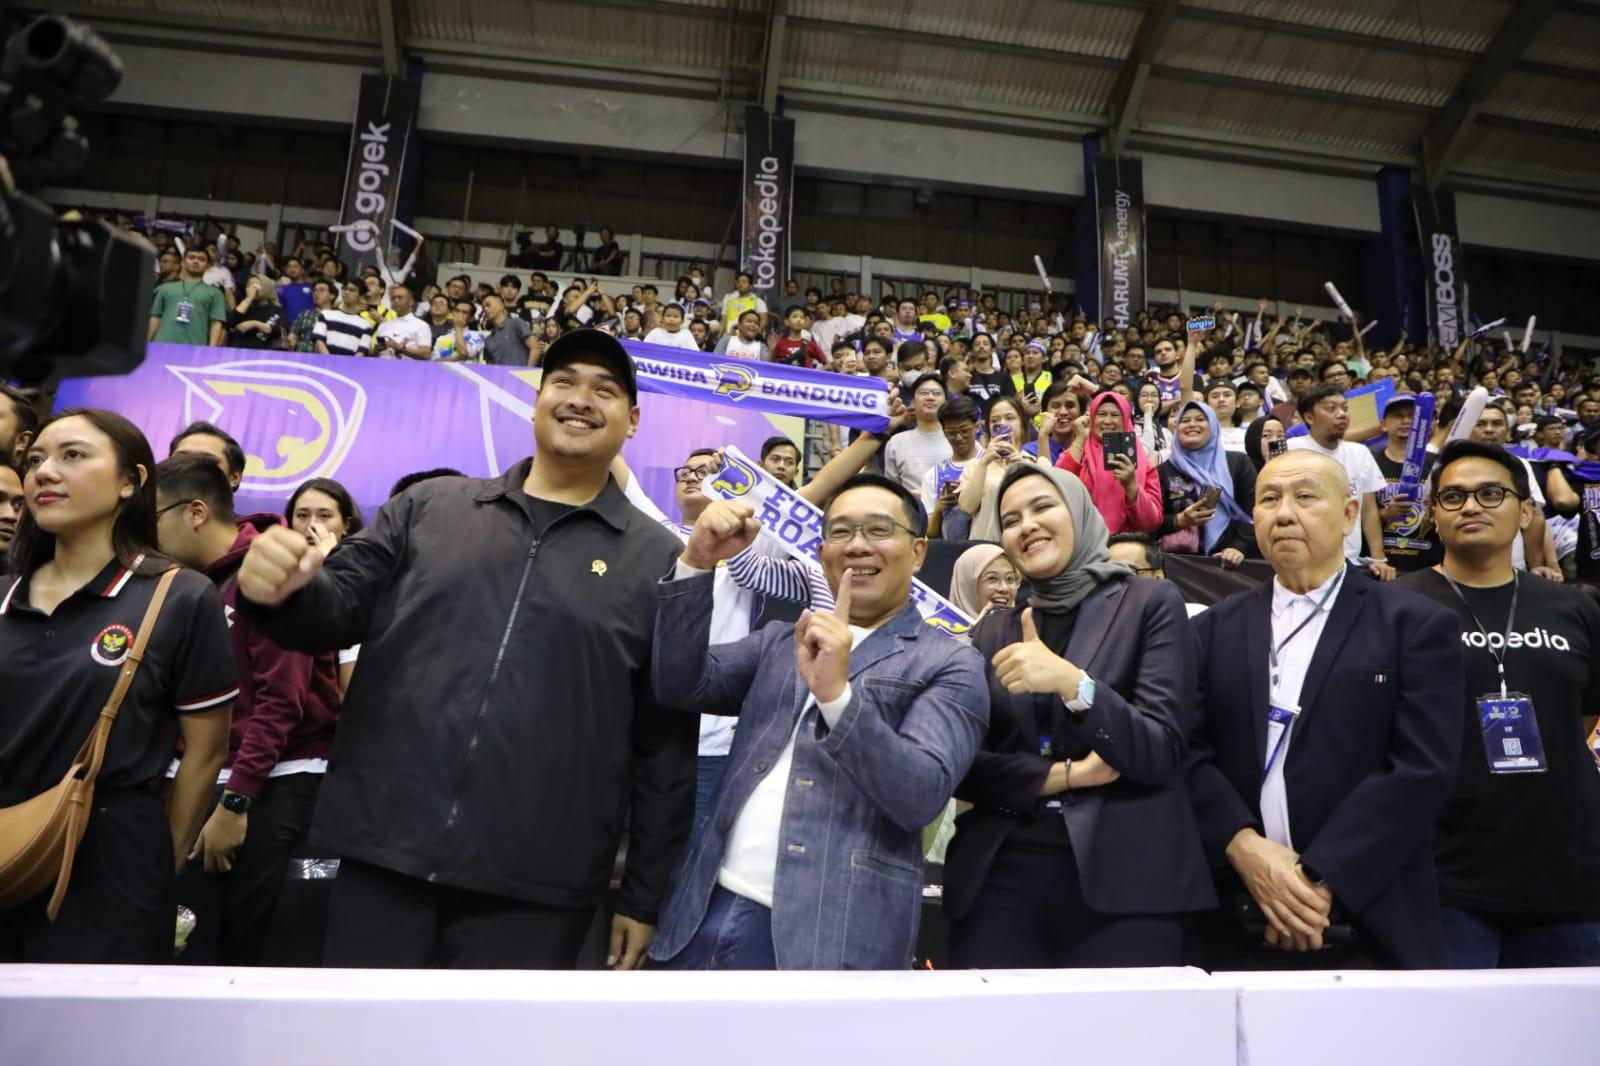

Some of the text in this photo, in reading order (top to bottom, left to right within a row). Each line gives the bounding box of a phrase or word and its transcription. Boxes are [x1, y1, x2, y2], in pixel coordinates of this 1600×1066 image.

[355, 121, 391, 215] gojek
[753, 156, 783, 289] tokopedia
[1113, 190, 1131, 329] HARUM energy
[762, 381, 877, 409] BANDUNG
